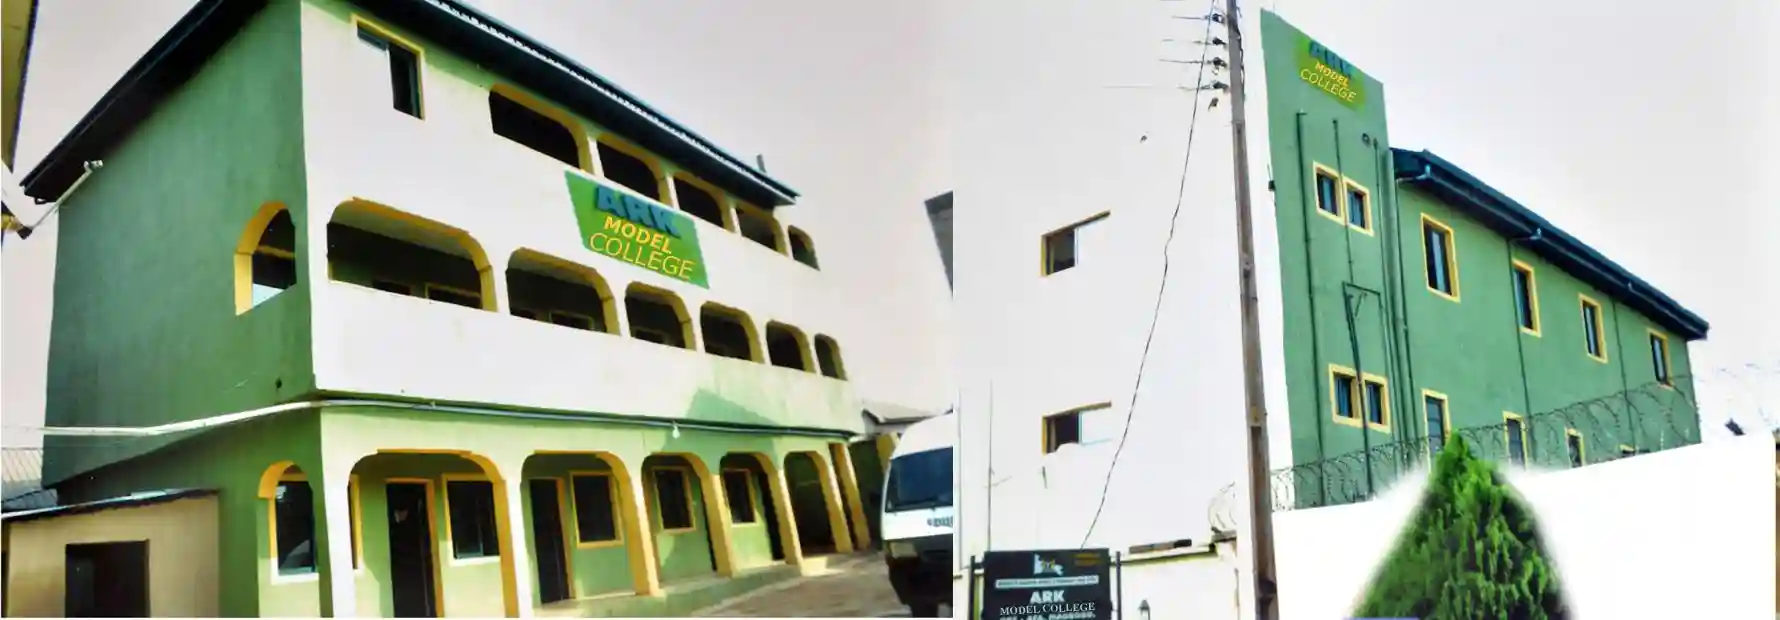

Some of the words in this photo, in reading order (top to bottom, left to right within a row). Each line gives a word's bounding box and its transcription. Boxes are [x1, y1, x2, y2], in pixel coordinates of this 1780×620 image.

[1300, 69, 1357, 103] COLLEGE
[1315, 60, 1349, 87] MODEL
[595, 184, 682, 239] ARK
[604, 215, 672, 254] MODEL
[589, 232, 696, 280] COLLEGE
[1000, 606, 1040, 615] MODEL
[1042, 602, 1096, 614] COLLEGE
[1029, 590, 1065, 603] ARK
